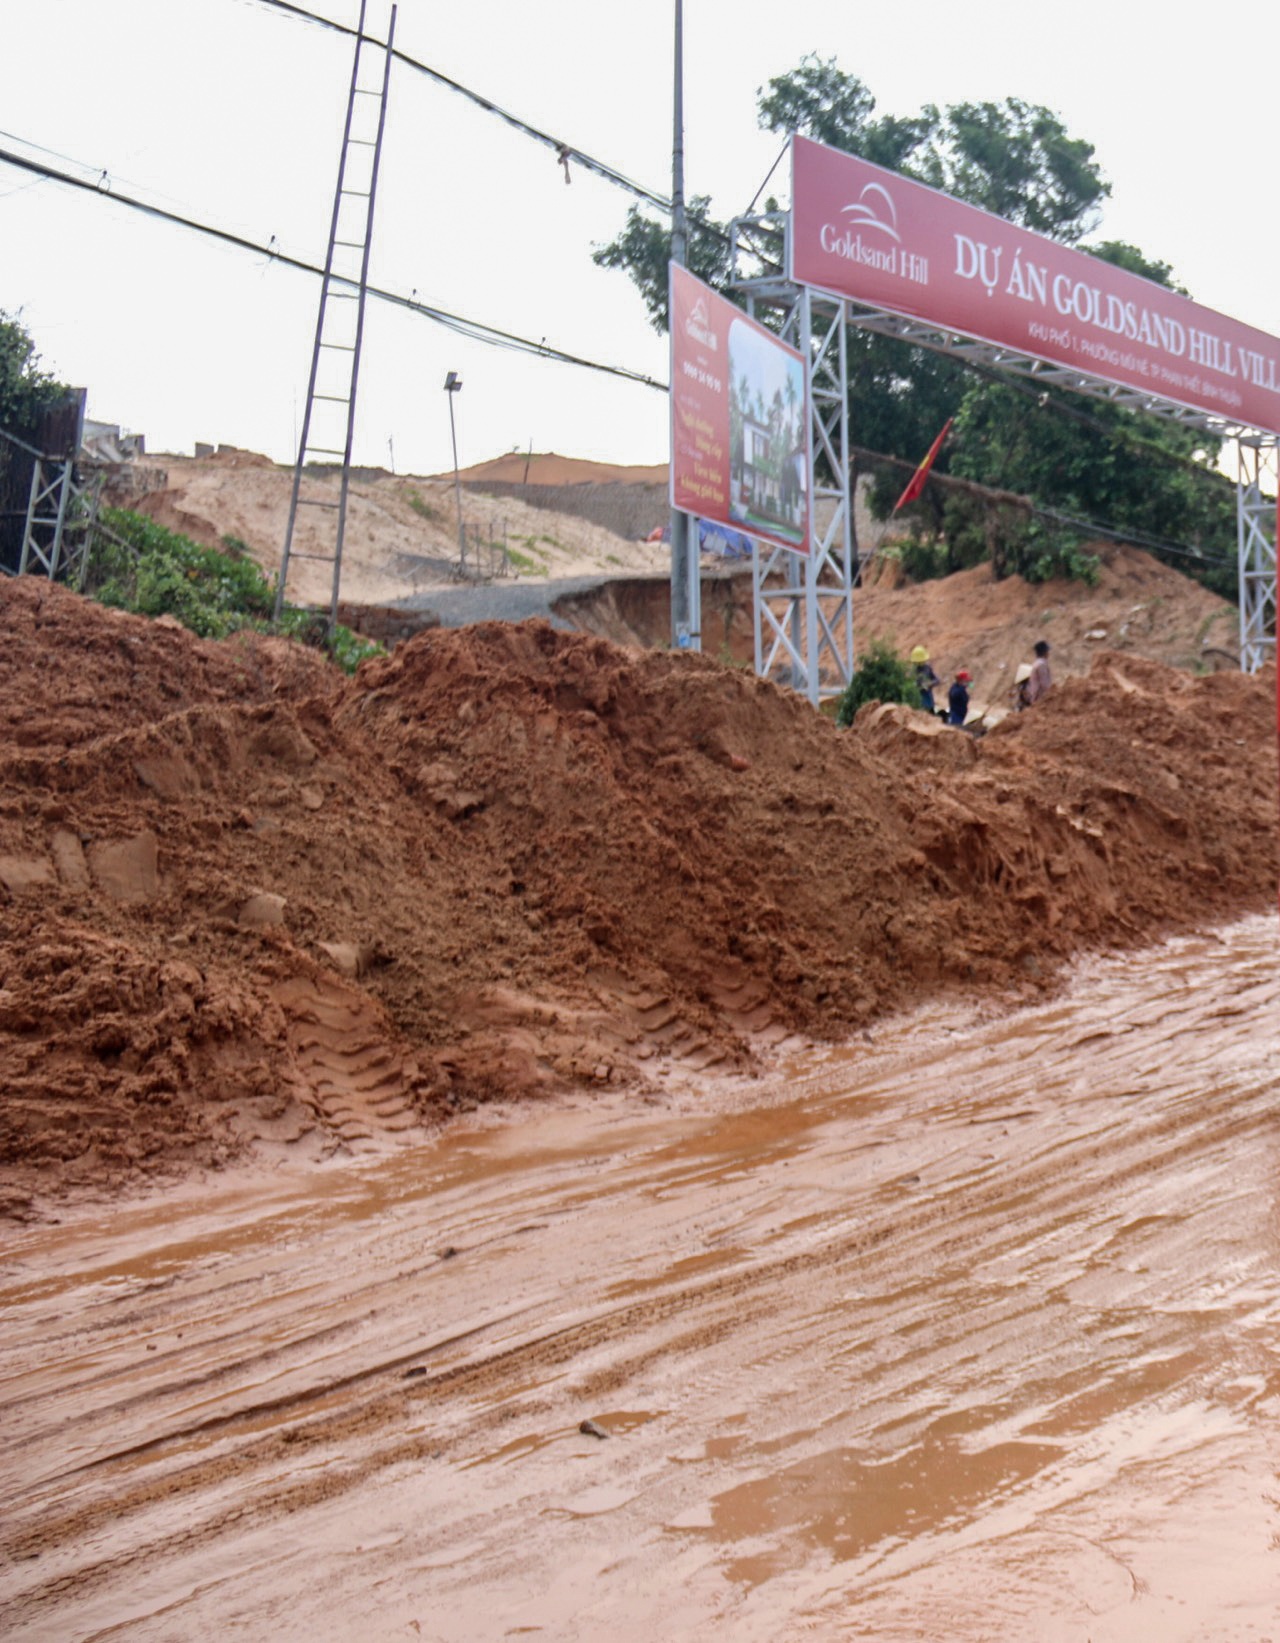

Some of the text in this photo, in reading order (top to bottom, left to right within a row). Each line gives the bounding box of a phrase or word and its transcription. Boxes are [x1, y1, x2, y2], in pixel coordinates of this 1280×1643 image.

[820, 223, 929, 286] Goldsand Hill
[953, 233, 1003, 297] DỰ
[1006, 246, 1048, 307] ÁN
[1053, 274, 1187, 357] GOLDSAND
[1189, 327, 1239, 377] HILL
